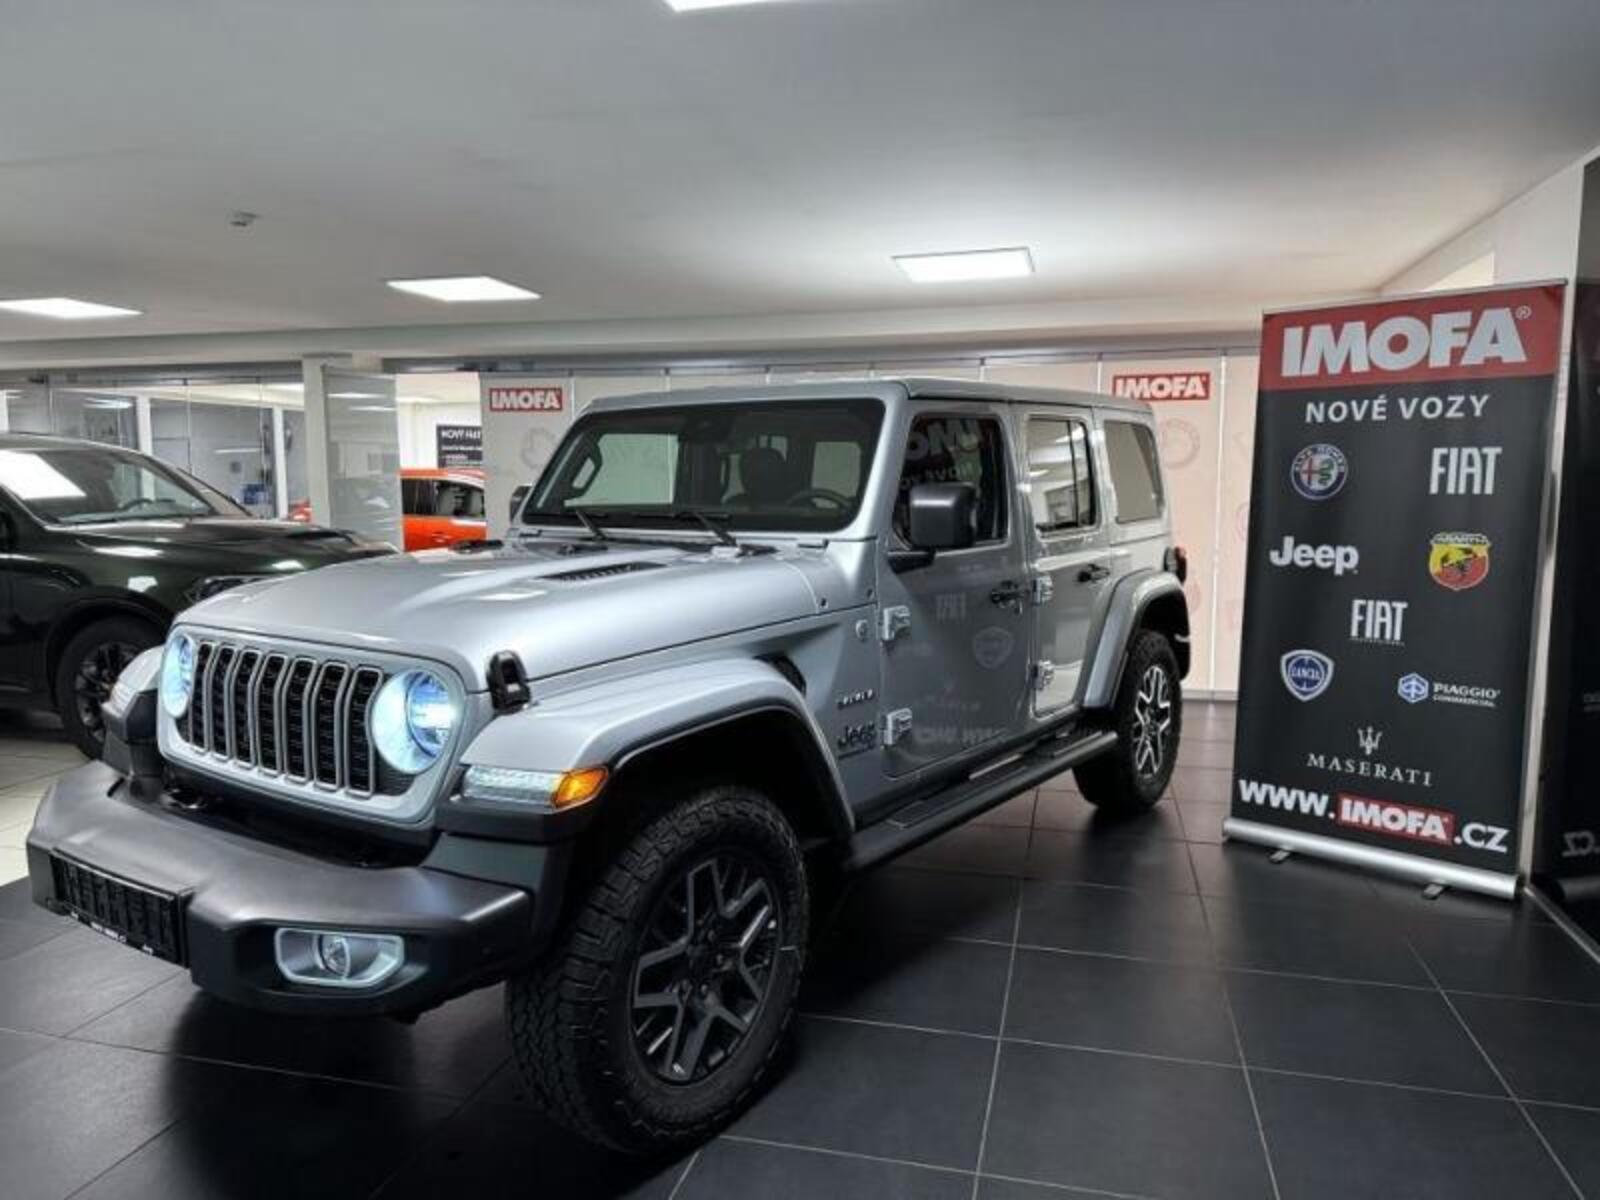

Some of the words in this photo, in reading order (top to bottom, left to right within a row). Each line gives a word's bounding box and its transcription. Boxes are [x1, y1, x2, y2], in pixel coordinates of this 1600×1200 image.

[491, 390, 560, 411] IMOFA
[1115, 376, 1207, 399] IMOFA
[1305, 395, 1388, 424] NOVÉ
[1398, 394, 1490, 421] VOZY
[1429, 446, 1503, 495] FIAT
[1269, 536, 1359, 576] Jeep
[1351, 599, 1409, 641] FIAT
[1306, 753, 1434, 788] MASERATI
